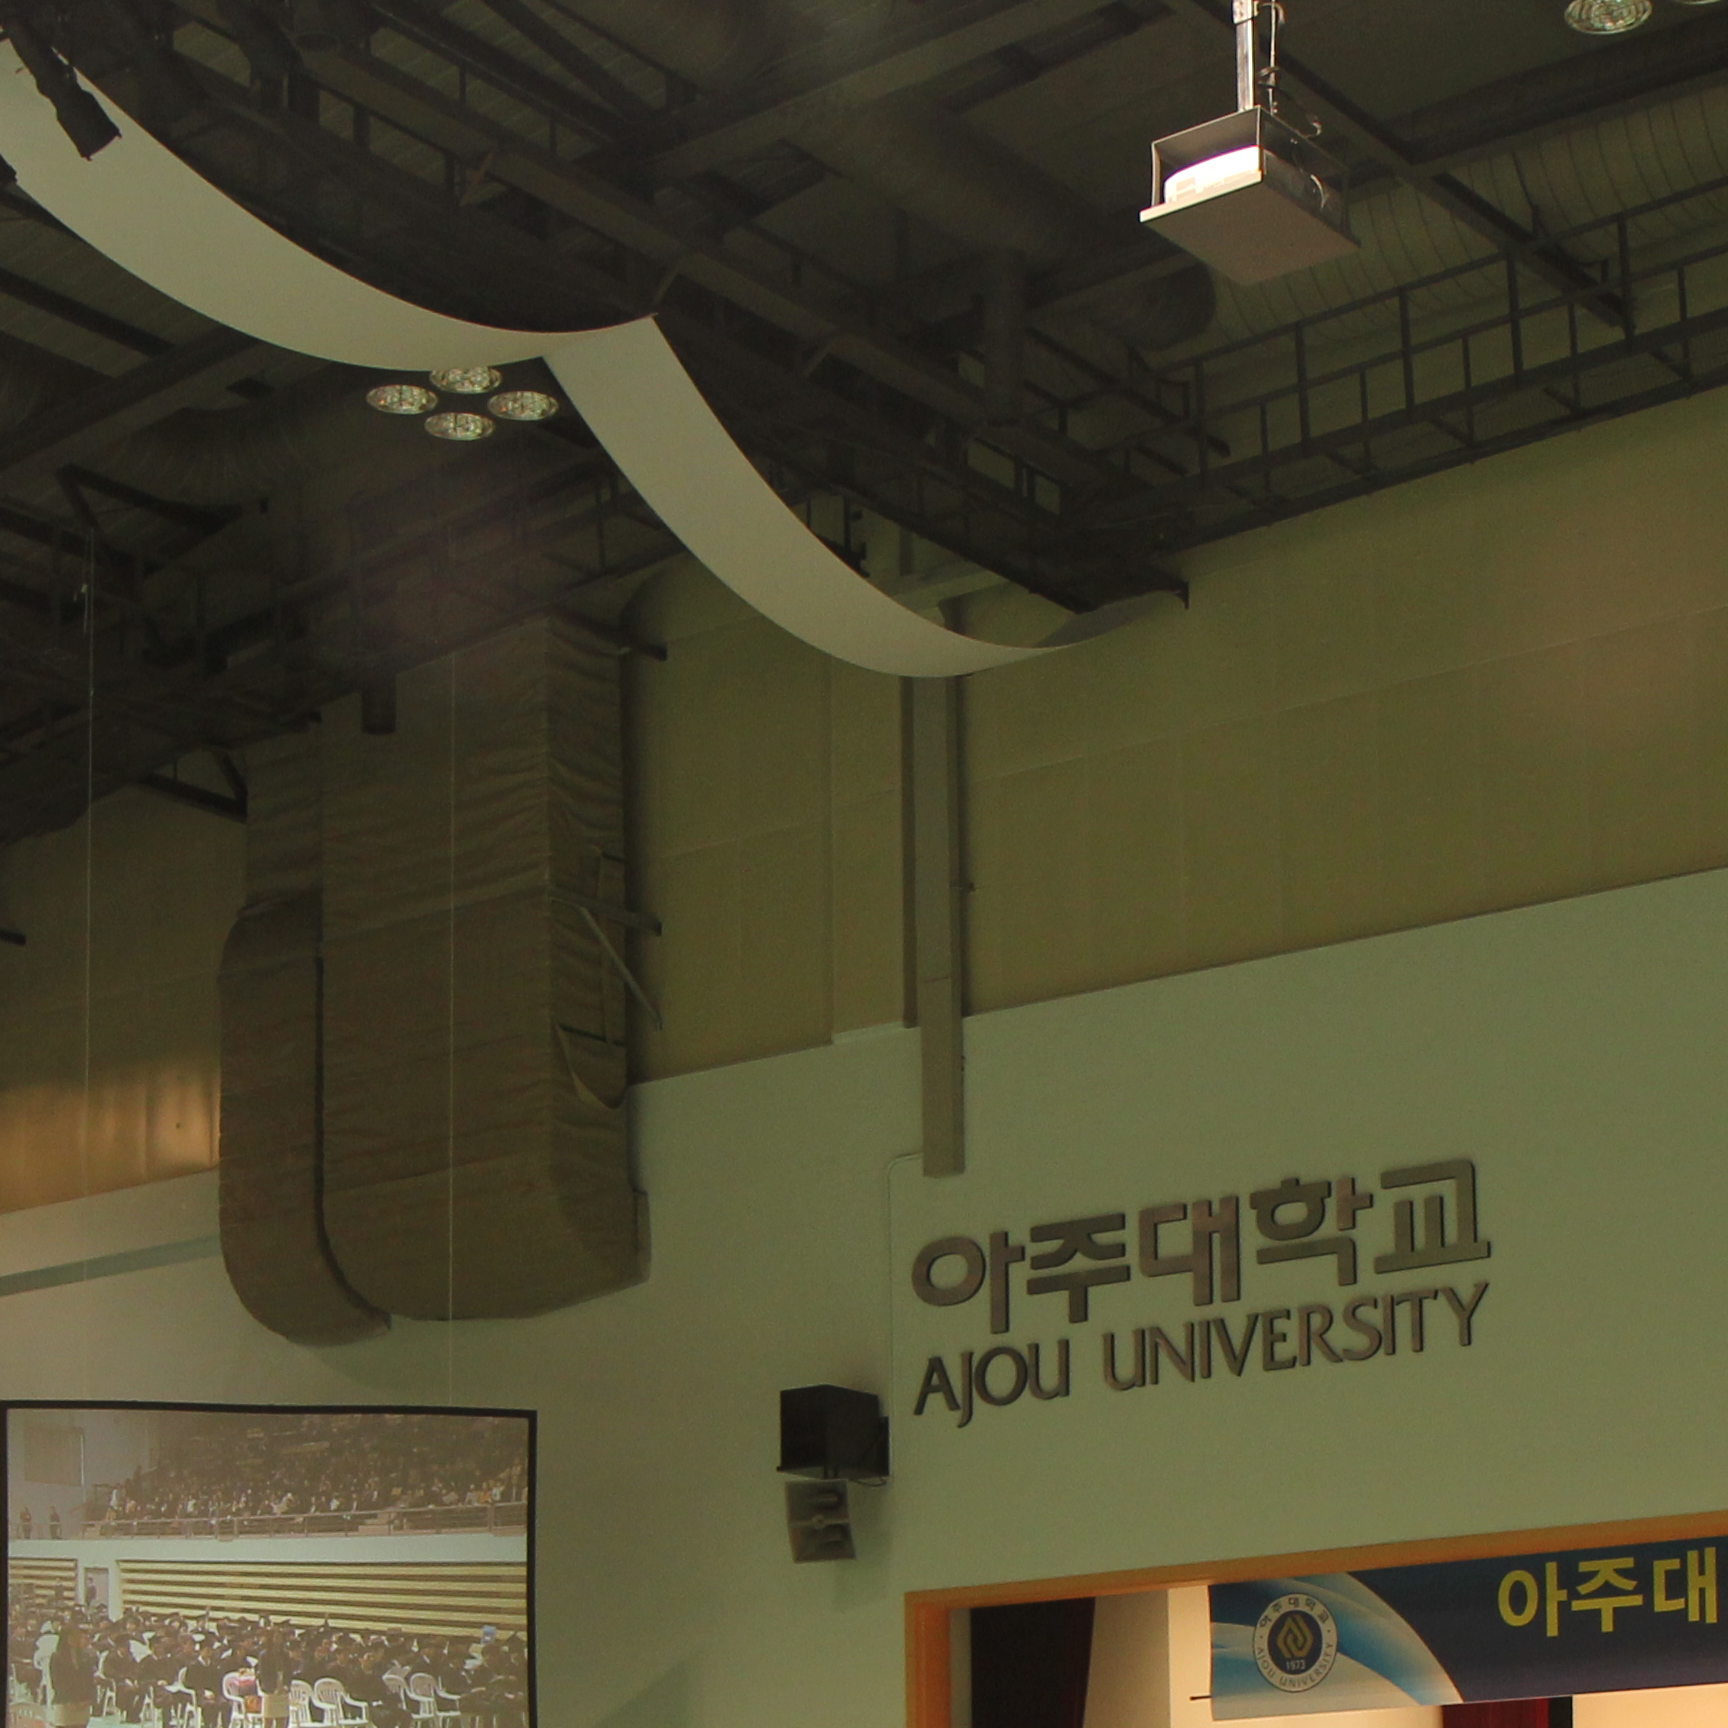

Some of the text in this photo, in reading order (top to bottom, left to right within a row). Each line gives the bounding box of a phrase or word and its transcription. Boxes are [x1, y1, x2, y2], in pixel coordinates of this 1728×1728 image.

[911, 1159, 1491, 1333] 아주대학교
[914, 1282, 1490, 1428] AJOU UNIVERSITY
[1285, 1659, 1306, 1671] 1973
